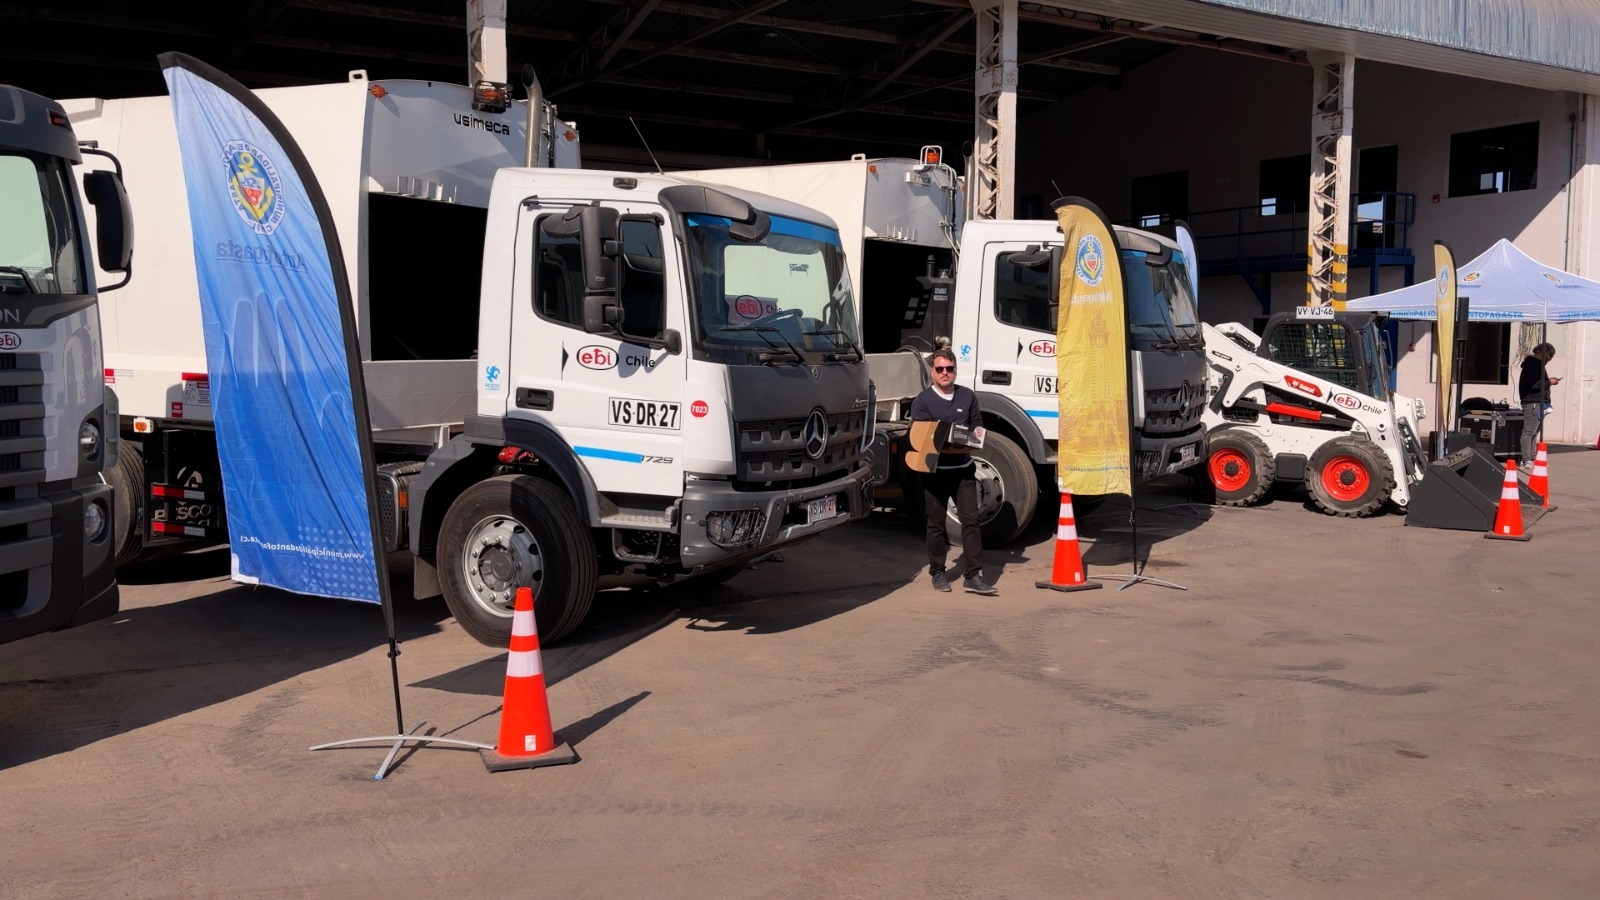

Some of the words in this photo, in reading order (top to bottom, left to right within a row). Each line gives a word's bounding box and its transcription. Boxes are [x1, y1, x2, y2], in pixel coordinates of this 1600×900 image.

[454, 113, 510, 136] usimeca
[0, 308, 20, 323] N
[1032, 342, 1056, 355] ebi
[580, 347, 613, 366] ebi
[625, 354, 656, 368] Chile
[691, 404, 708, 414] 7023
